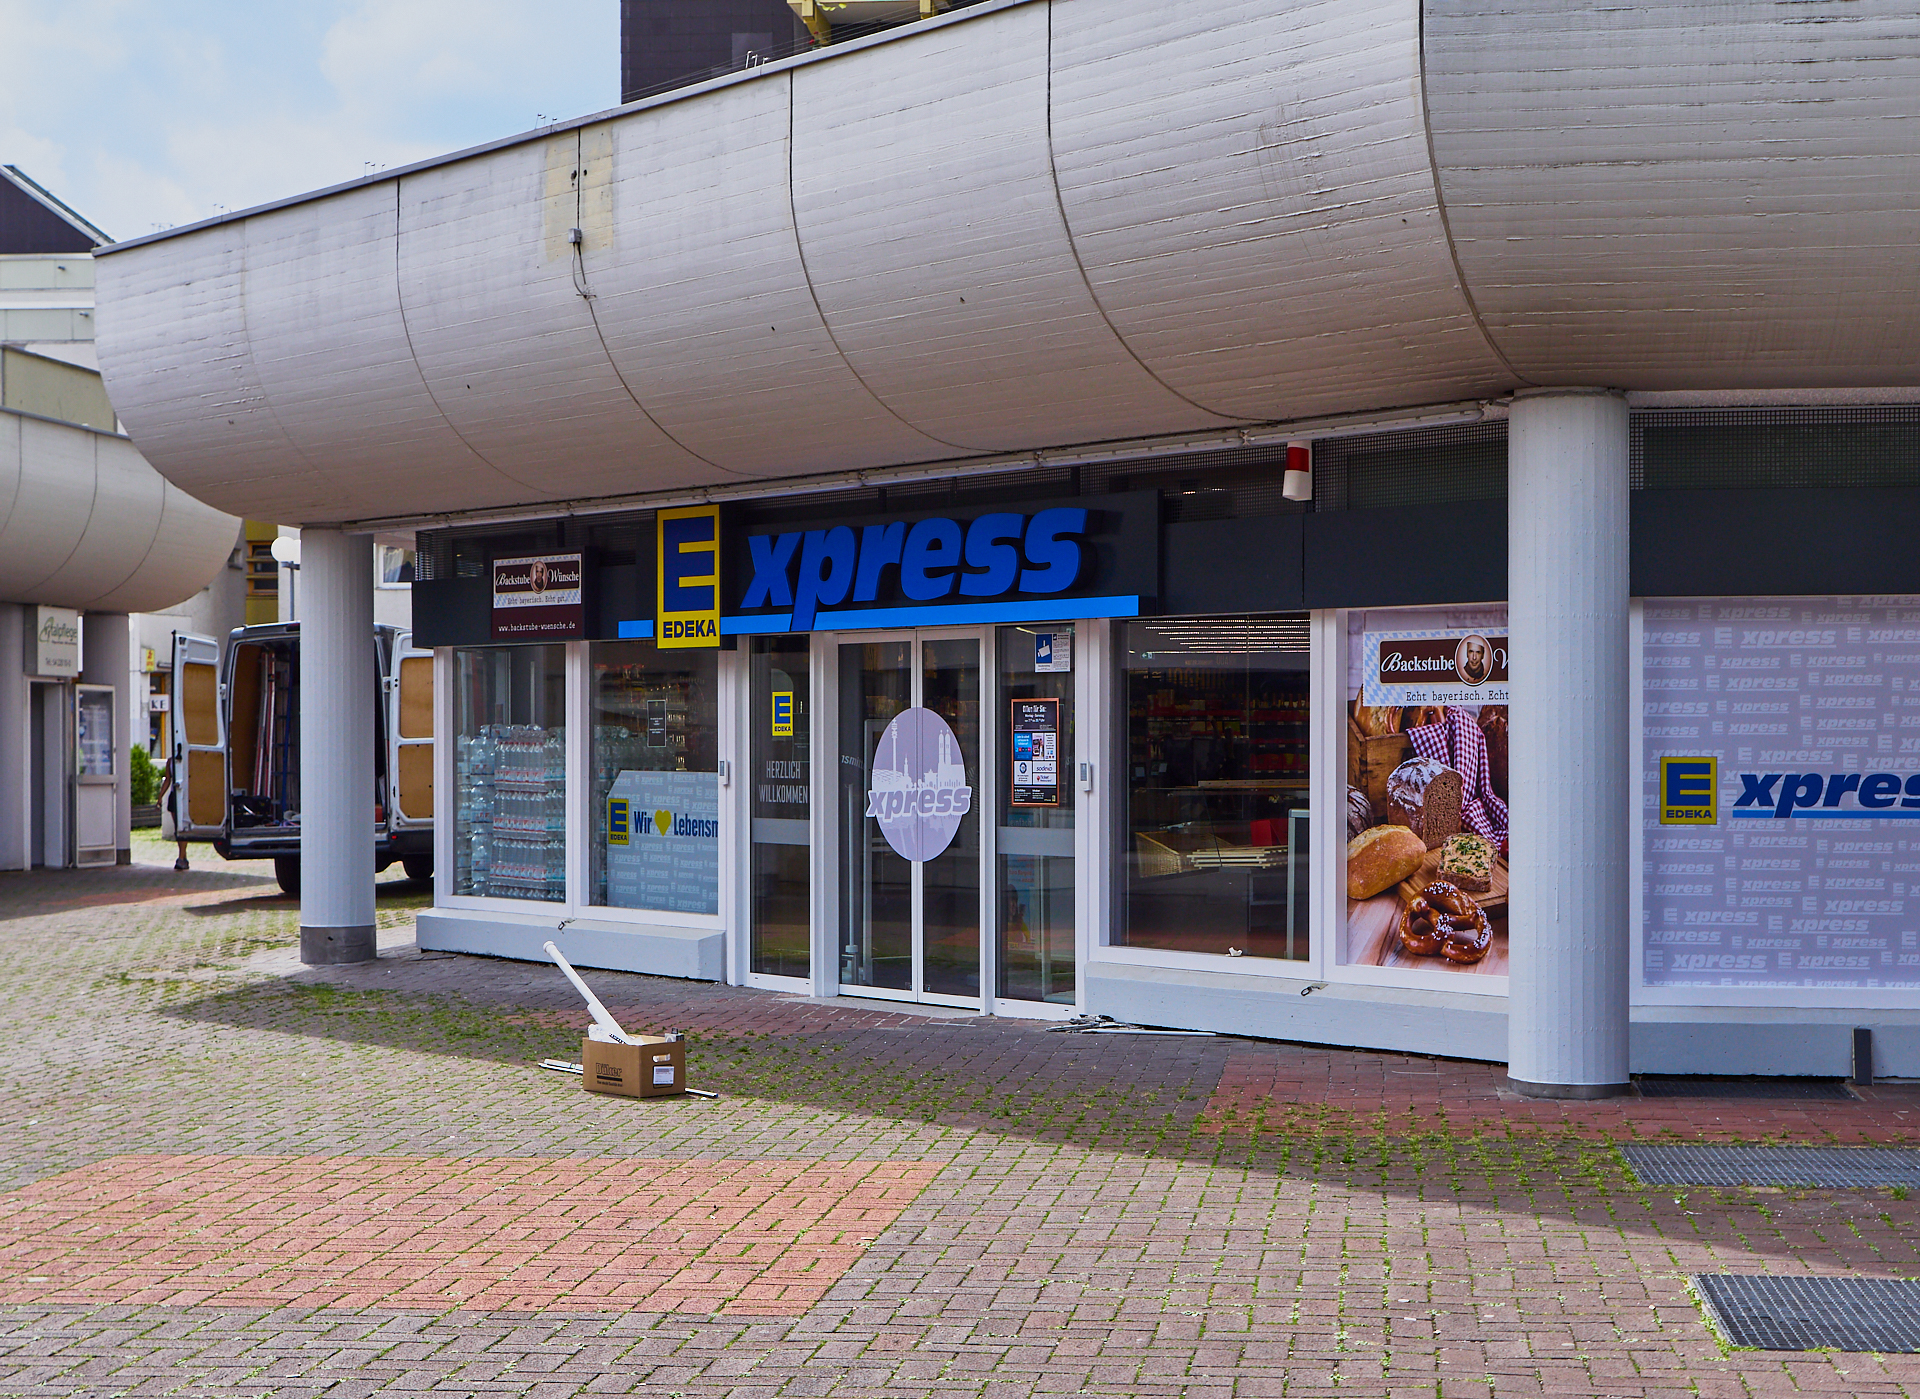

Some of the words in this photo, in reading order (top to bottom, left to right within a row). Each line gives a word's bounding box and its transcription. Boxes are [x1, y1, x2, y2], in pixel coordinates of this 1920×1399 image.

[662, 515, 716, 612] E
[740, 507, 1089, 632] xpress
[496, 572, 531, 587] Backstube
[547, 568, 580, 583] Wünsche
[508, 597, 518, 605] Echt
[519, 596, 544, 605] bayerisch.
[1718, 606, 1791, 621] xpress
[1816, 613, 1871, 624] xpress
[498, 621, 576, 632] www.backstube-wuensche.de
[662, 618, 718, 639] EDEKA
[1740, 630, 1836, 649] xpress
[1381, 651, 1455, 673] Backstube
[1720, 657, 1780, 669] xpress
[1806, 656, 1867, 668] xpress
[1726, 677, 1799, 691] xpress
[1824, 674, 1883, 686] xpress
[1406, 690, 1427, 702] Echt
[1432, 690, 1485, 703] bayerisch.
[1732, 702, 1789, 713] xpress
[1816, 697, 1876, 709] xpress
[774, 695, 791, 724] E
[1728, 723, 1788, 735] xpress
[1817, 719, 1877, 730] xpress
[1817, 736, 1869, 747] xpress
[1758, 750, 1833, 765] xpress
[766, 760, 801, 779] HERZLICH
[1666, 763, 1711, 806] E
[758, 784, 809, 804] WILLKOMMEN
[866, 786, 972, 822] xpress
[611, 802, 627, 833] E
[1665, 809, 1712, 819] EDEKA
[633, 811, 653, 834] Wir
[1726, 819, 1786, 831] xpress
[1812, 819, 1872, 831] xpress
[1651, 839, 1724, 853] xpress
[1749, 836, 1808, 848] xpress
[1833, 842, 1894, 853] xpress
[1657, 863, 1714, 875] xpress
[1741, 859, 1800, 870] xpress
[1828, 860, 1870, 868] xpress
[1654, 884, 1713, 895] xpress
[1741, 880, 1801, 891] xpress
[1824, 878, 1885, 890] xpress
[1741, 897, 1793, 907] xpress
[1824, 899, 1904, 915] xpress
[1683, 911, 1759, 926] xpress
[1789, 919, 1869, 935] xpress
[1649, 931, 1721, 945] xpress
[1747, 938, 1801, 949] xpress
[1832, 938, 1887, 949] xpress
[1671, 953, 1767, 973] xpress
[1797, 955, 1870, 970] xpress
